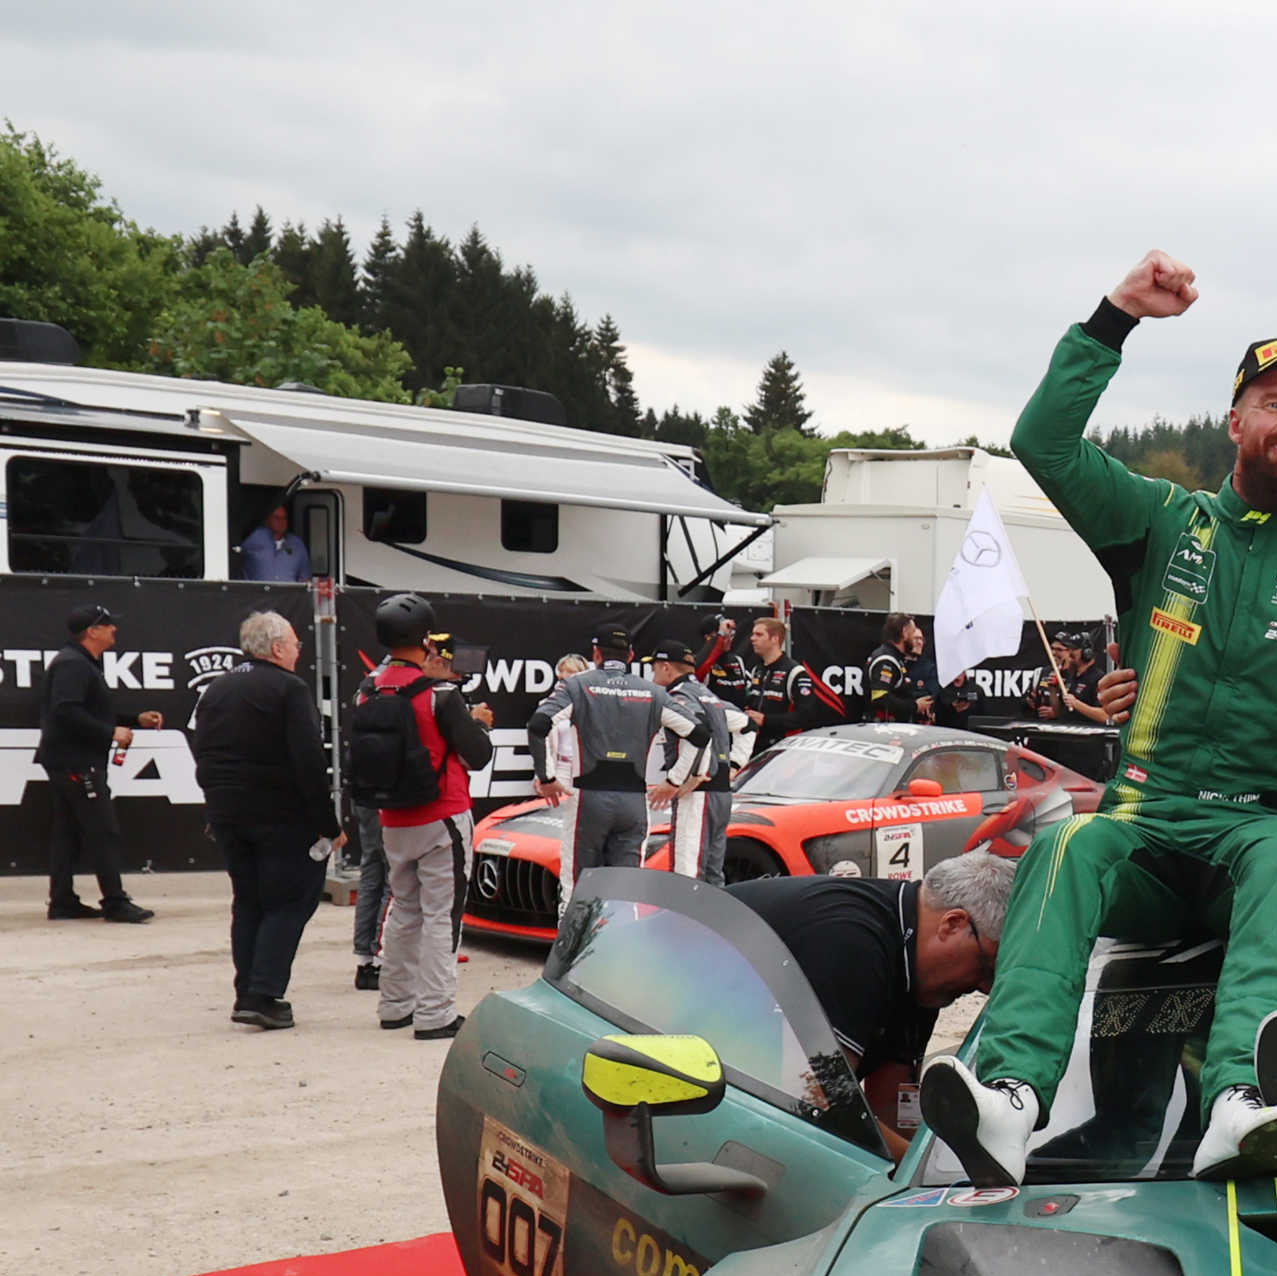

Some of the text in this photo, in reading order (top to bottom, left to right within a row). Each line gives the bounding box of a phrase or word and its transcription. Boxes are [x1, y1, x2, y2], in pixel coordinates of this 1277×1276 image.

[1152, 610, 1195, 641] PIRELLI
[190, 653, 233, 675] 1924
[844, 800, 968, 824] CROWDSTRIKE
[889, 841, 911, 868] 4
